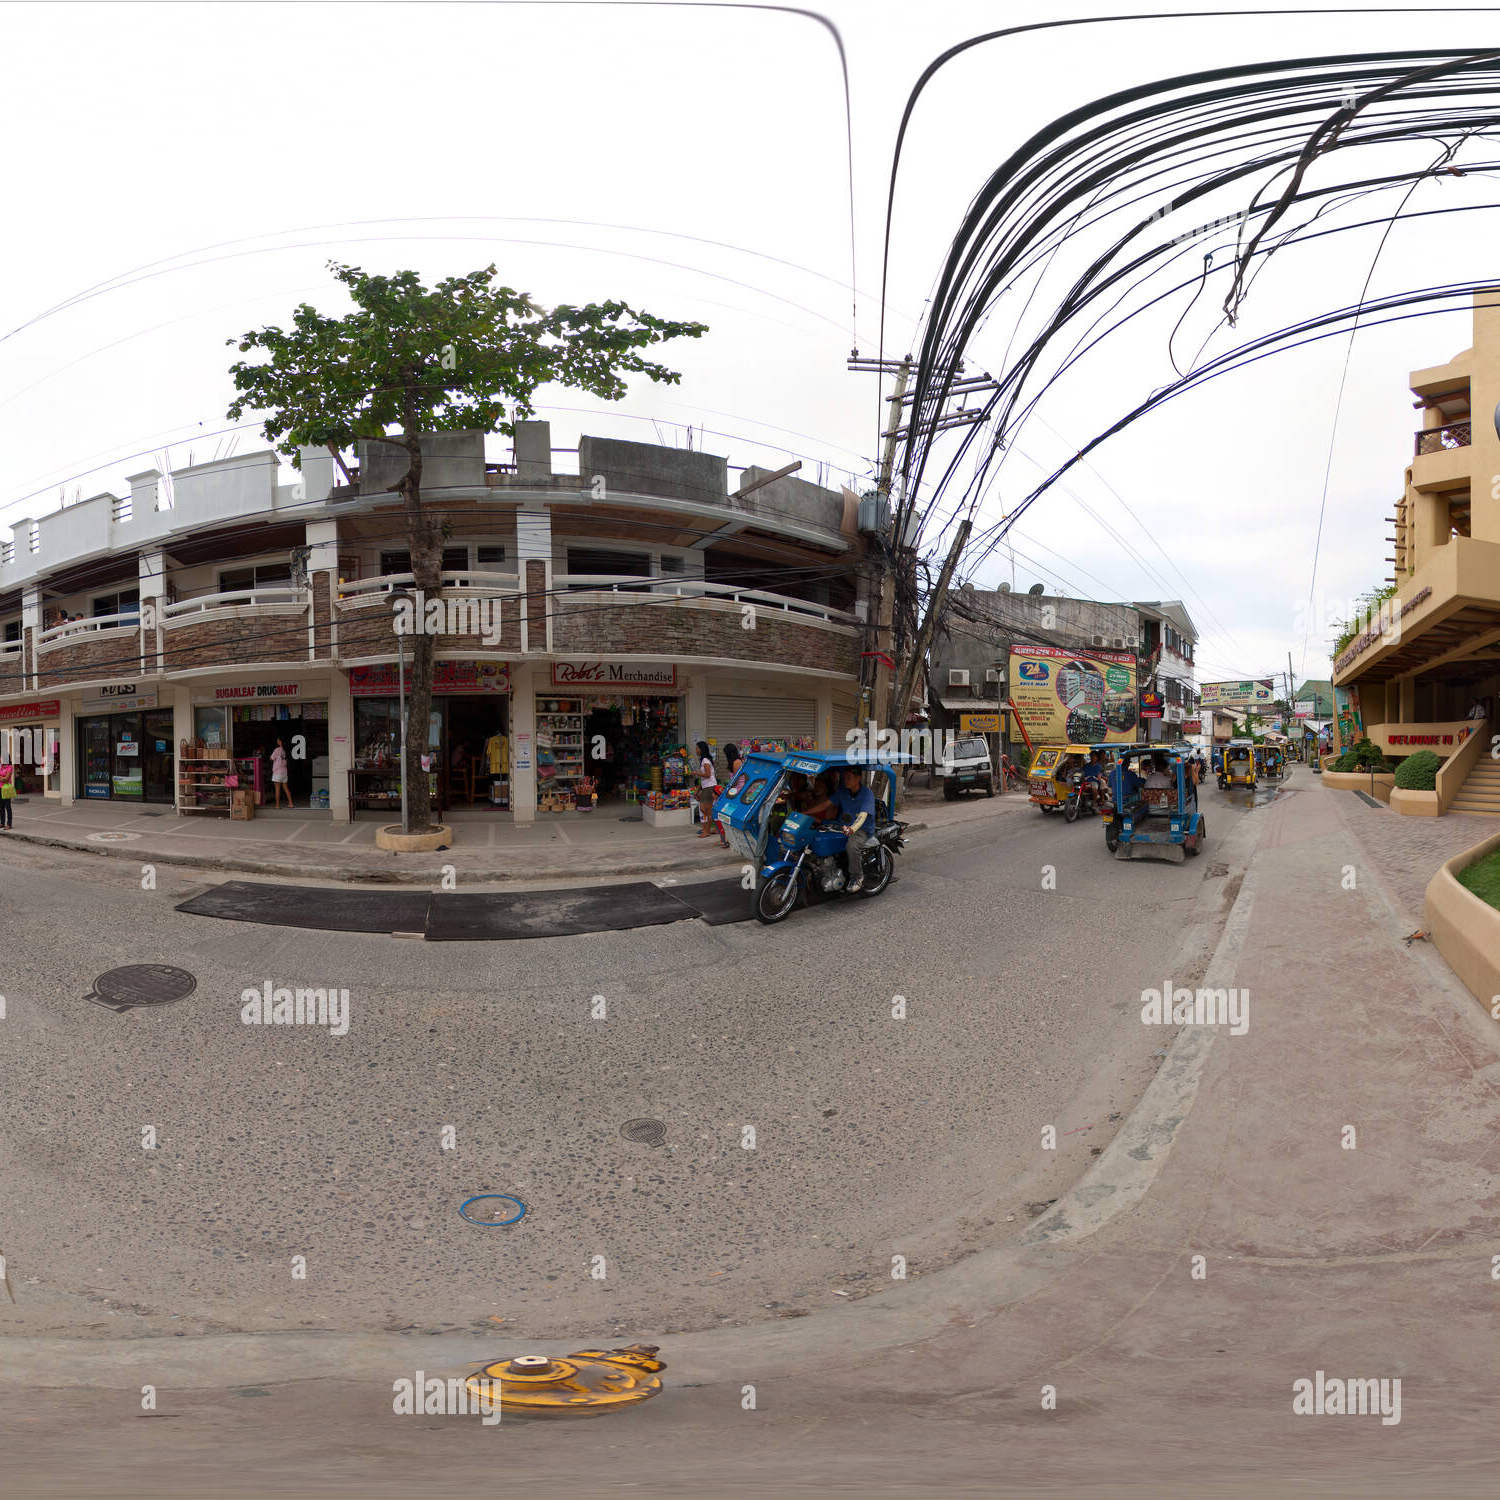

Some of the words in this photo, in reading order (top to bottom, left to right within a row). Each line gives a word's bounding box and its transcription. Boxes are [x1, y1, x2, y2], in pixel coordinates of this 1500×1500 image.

[608, 664, 672, 682] Merchandise
[215, 685, 256, 699] SUGARLEAF
[257, 683, 299, 697] DRUGMART
